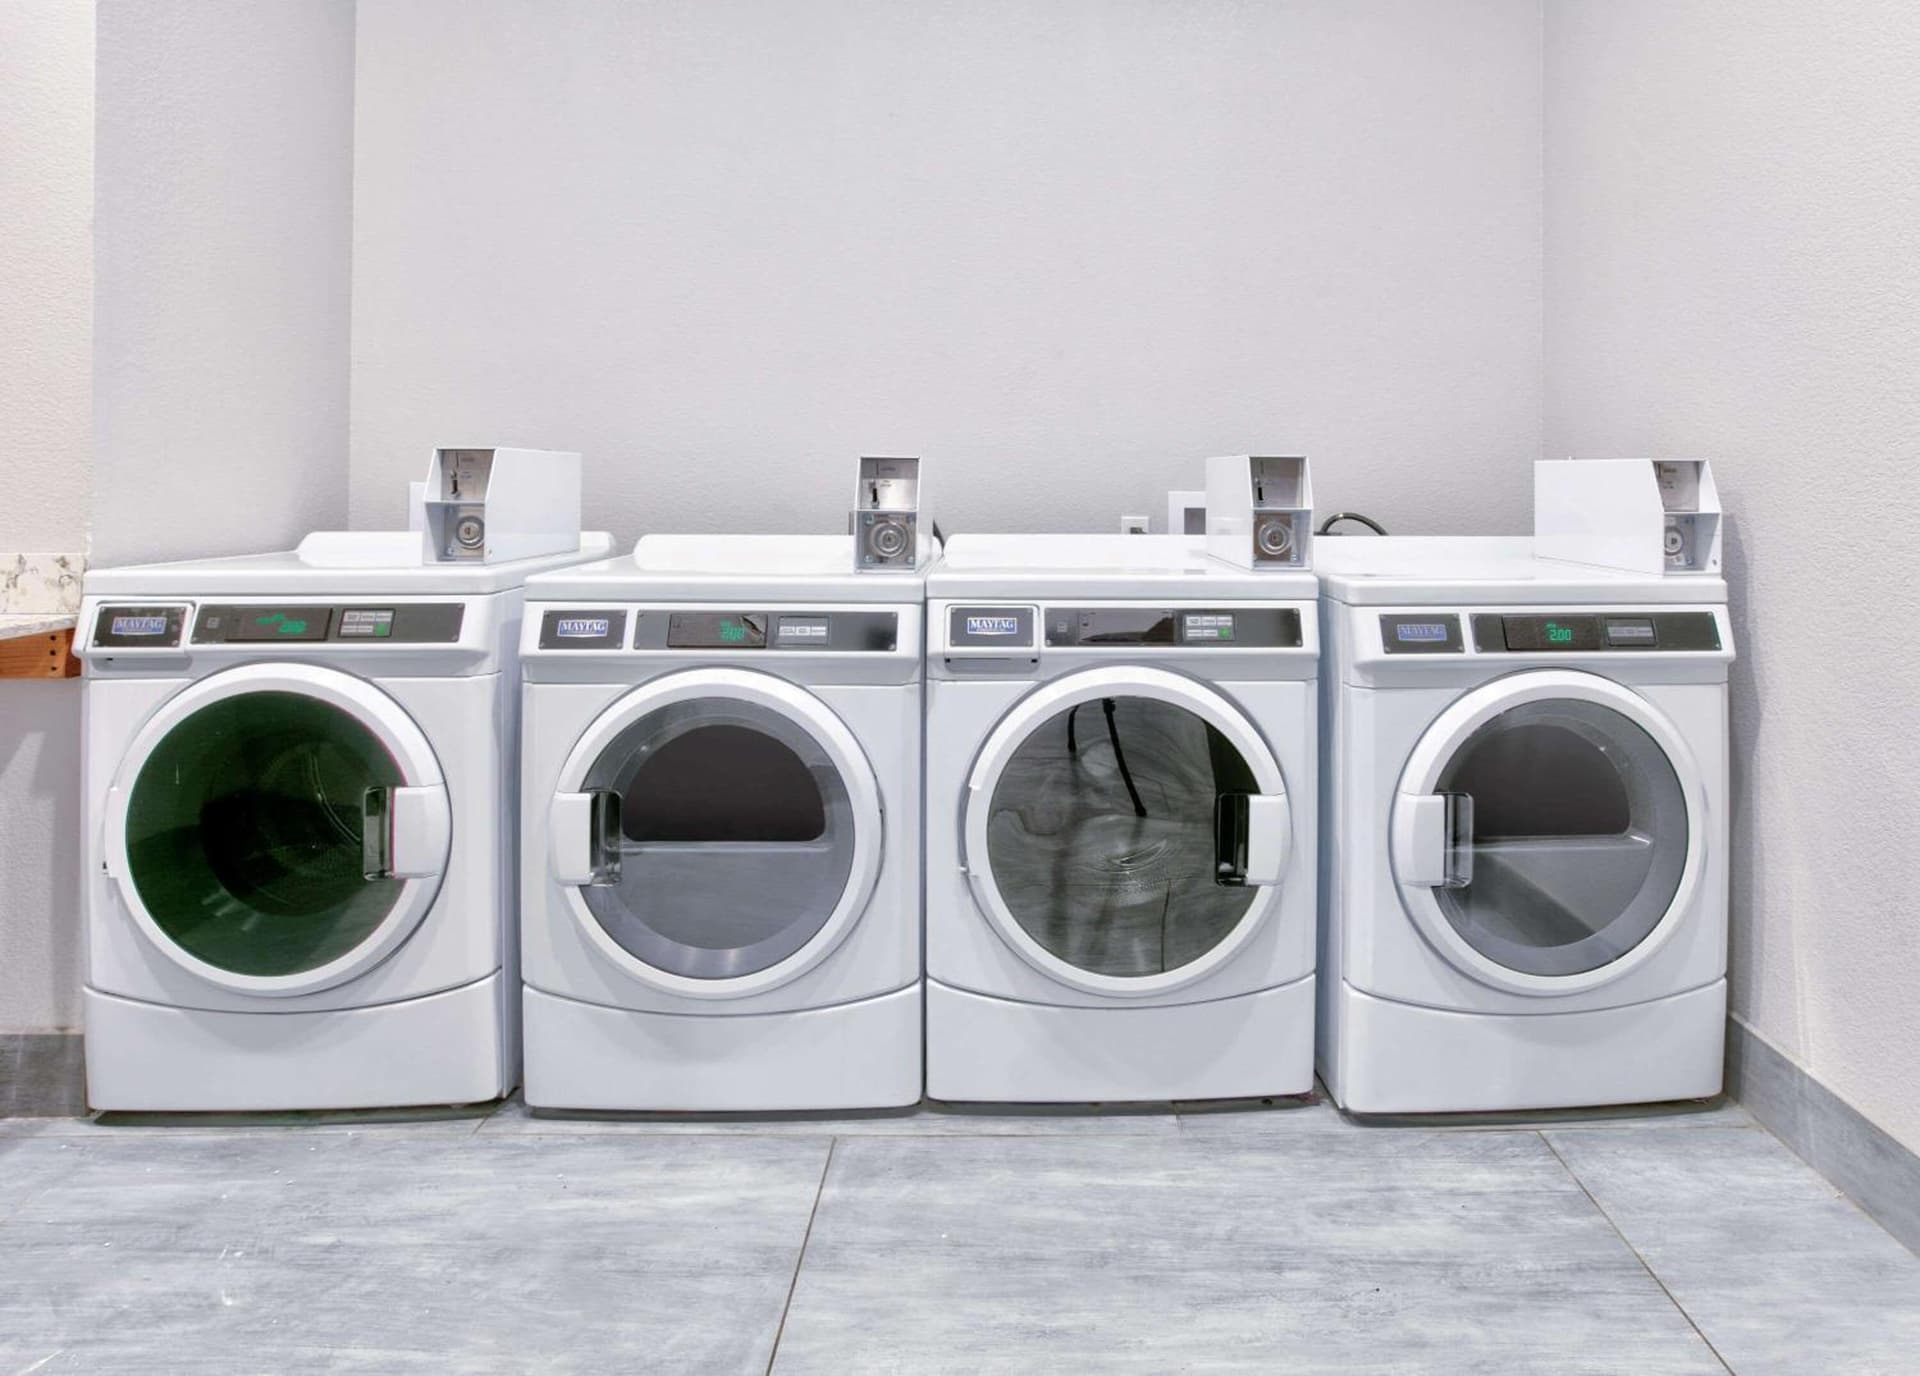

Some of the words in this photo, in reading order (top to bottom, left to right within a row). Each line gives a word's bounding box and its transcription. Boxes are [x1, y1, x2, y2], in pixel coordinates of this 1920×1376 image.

[116, 619, 162, 629] MAYTAG
[560, 621, 605, 631] MAYTAG
[970, 619, 1014, 629] MAYTAG
